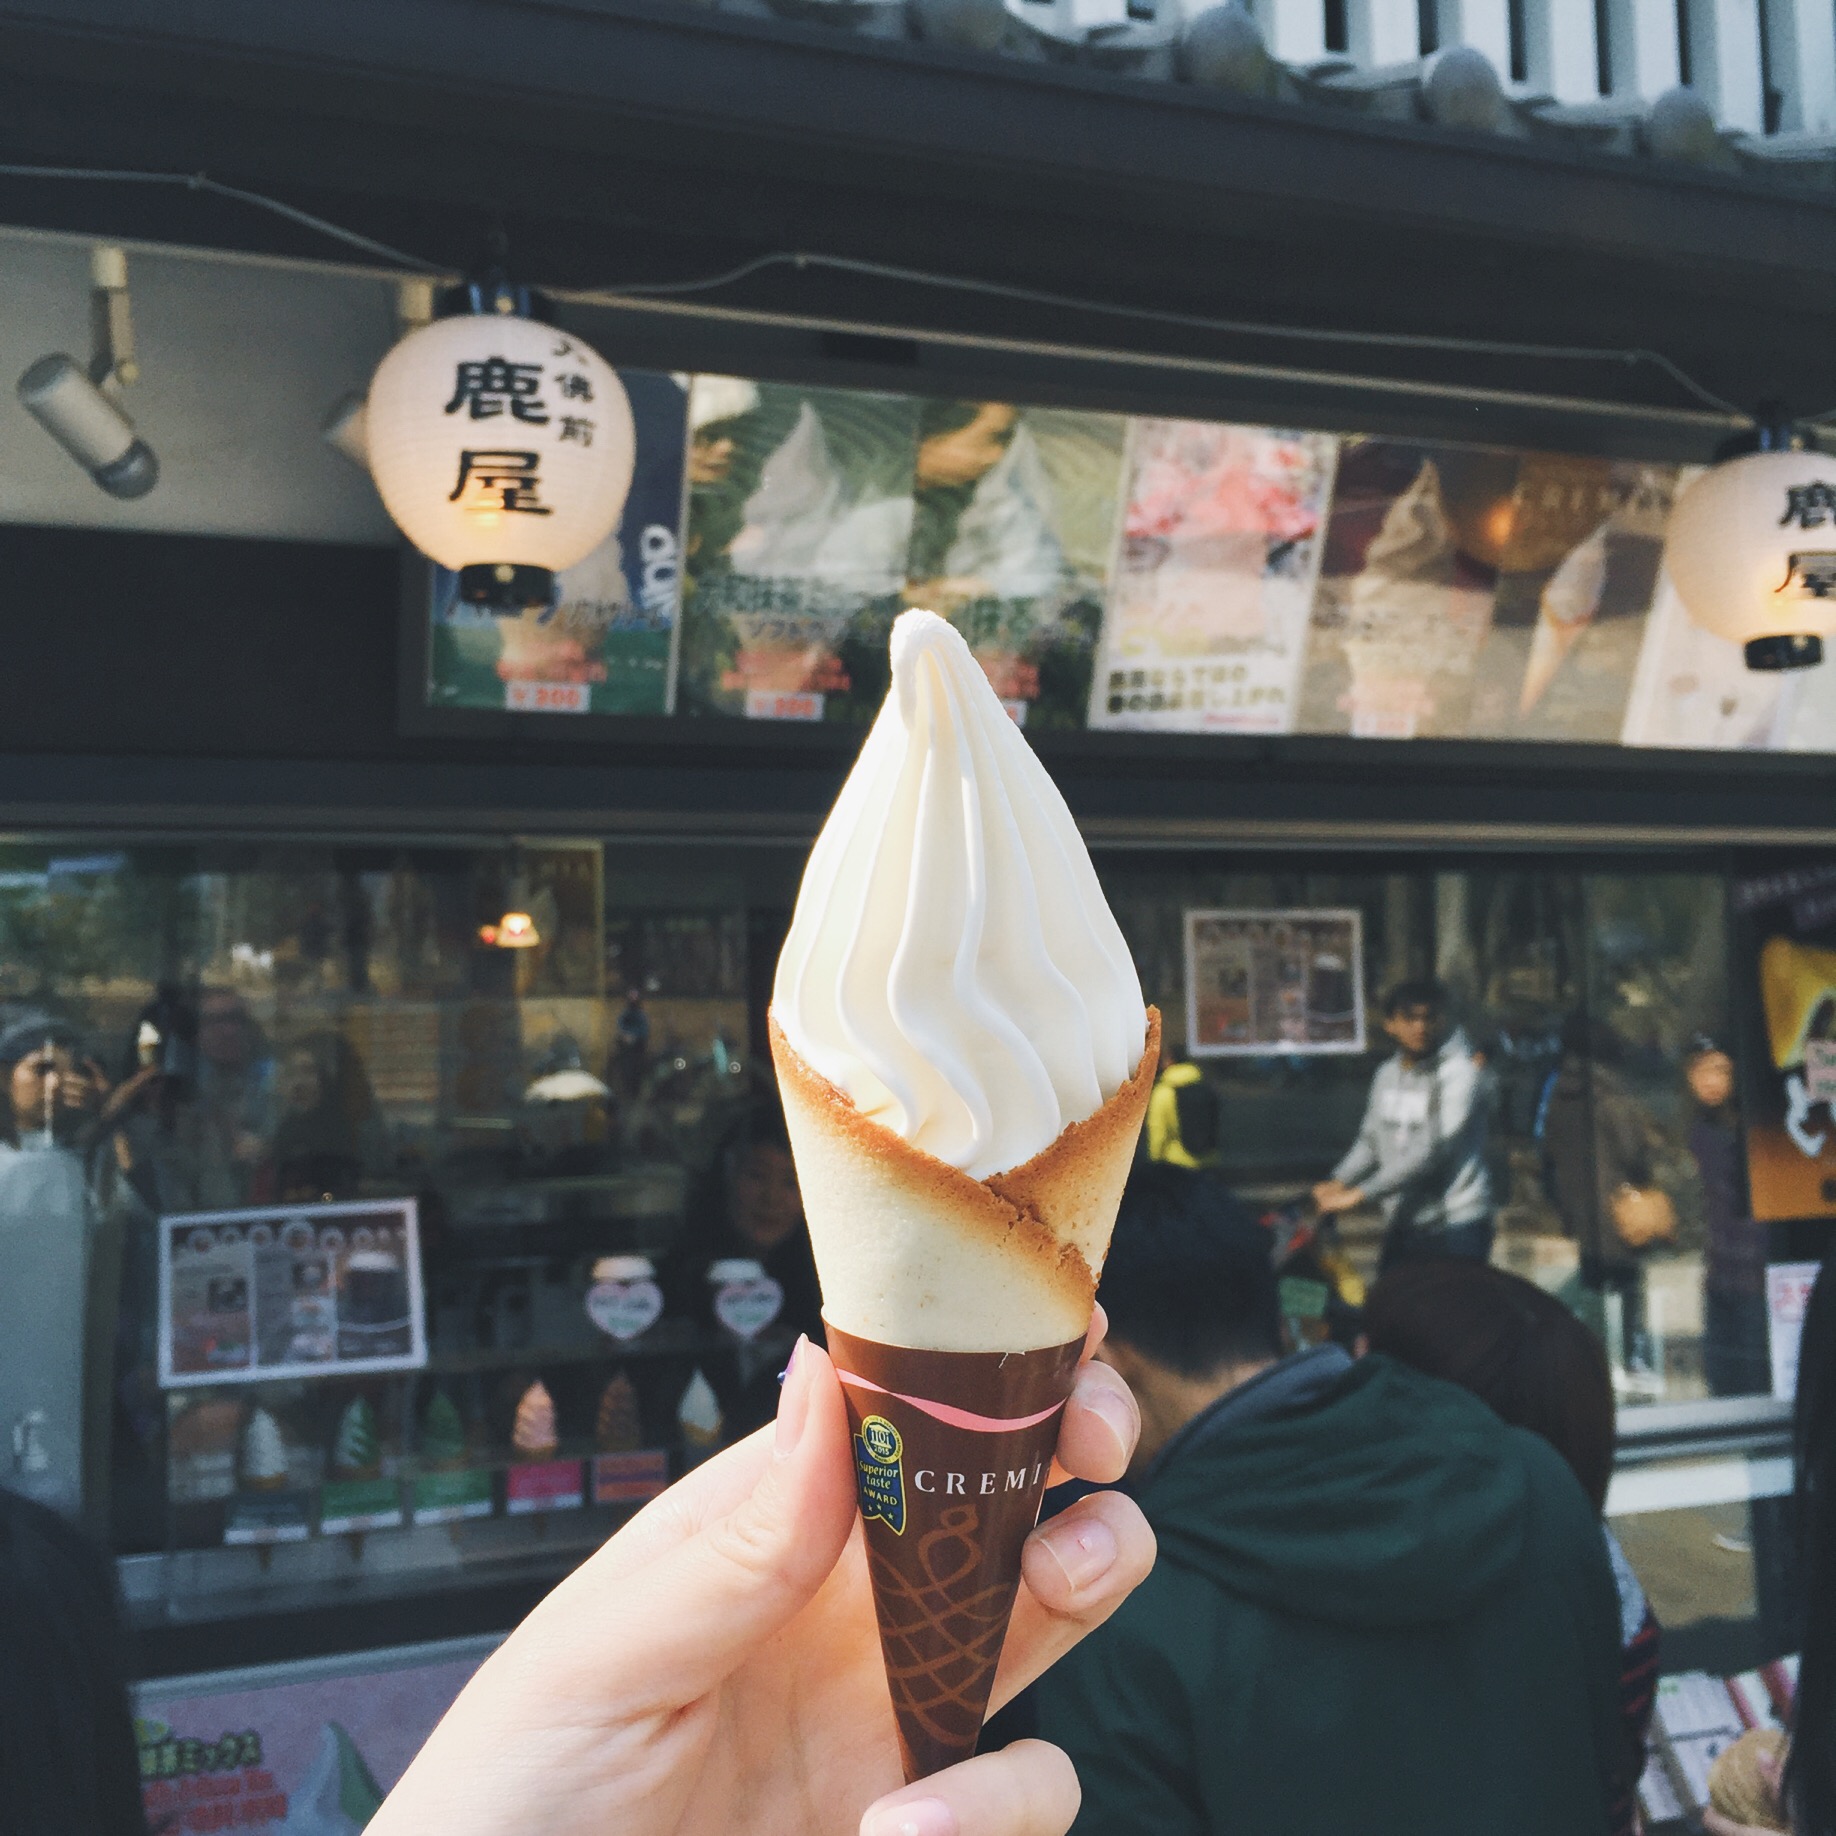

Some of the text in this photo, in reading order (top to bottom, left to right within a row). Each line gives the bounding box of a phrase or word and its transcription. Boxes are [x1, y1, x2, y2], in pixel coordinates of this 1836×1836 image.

[444, 356, 553, 515] 鹿屋
[873, 1445, 890, 1456] 2015
[859, 1460, 899, 1478] Superior
[866, 1474, 891, 1490] taste
[863, 1486, 898, 1506] AWARD
